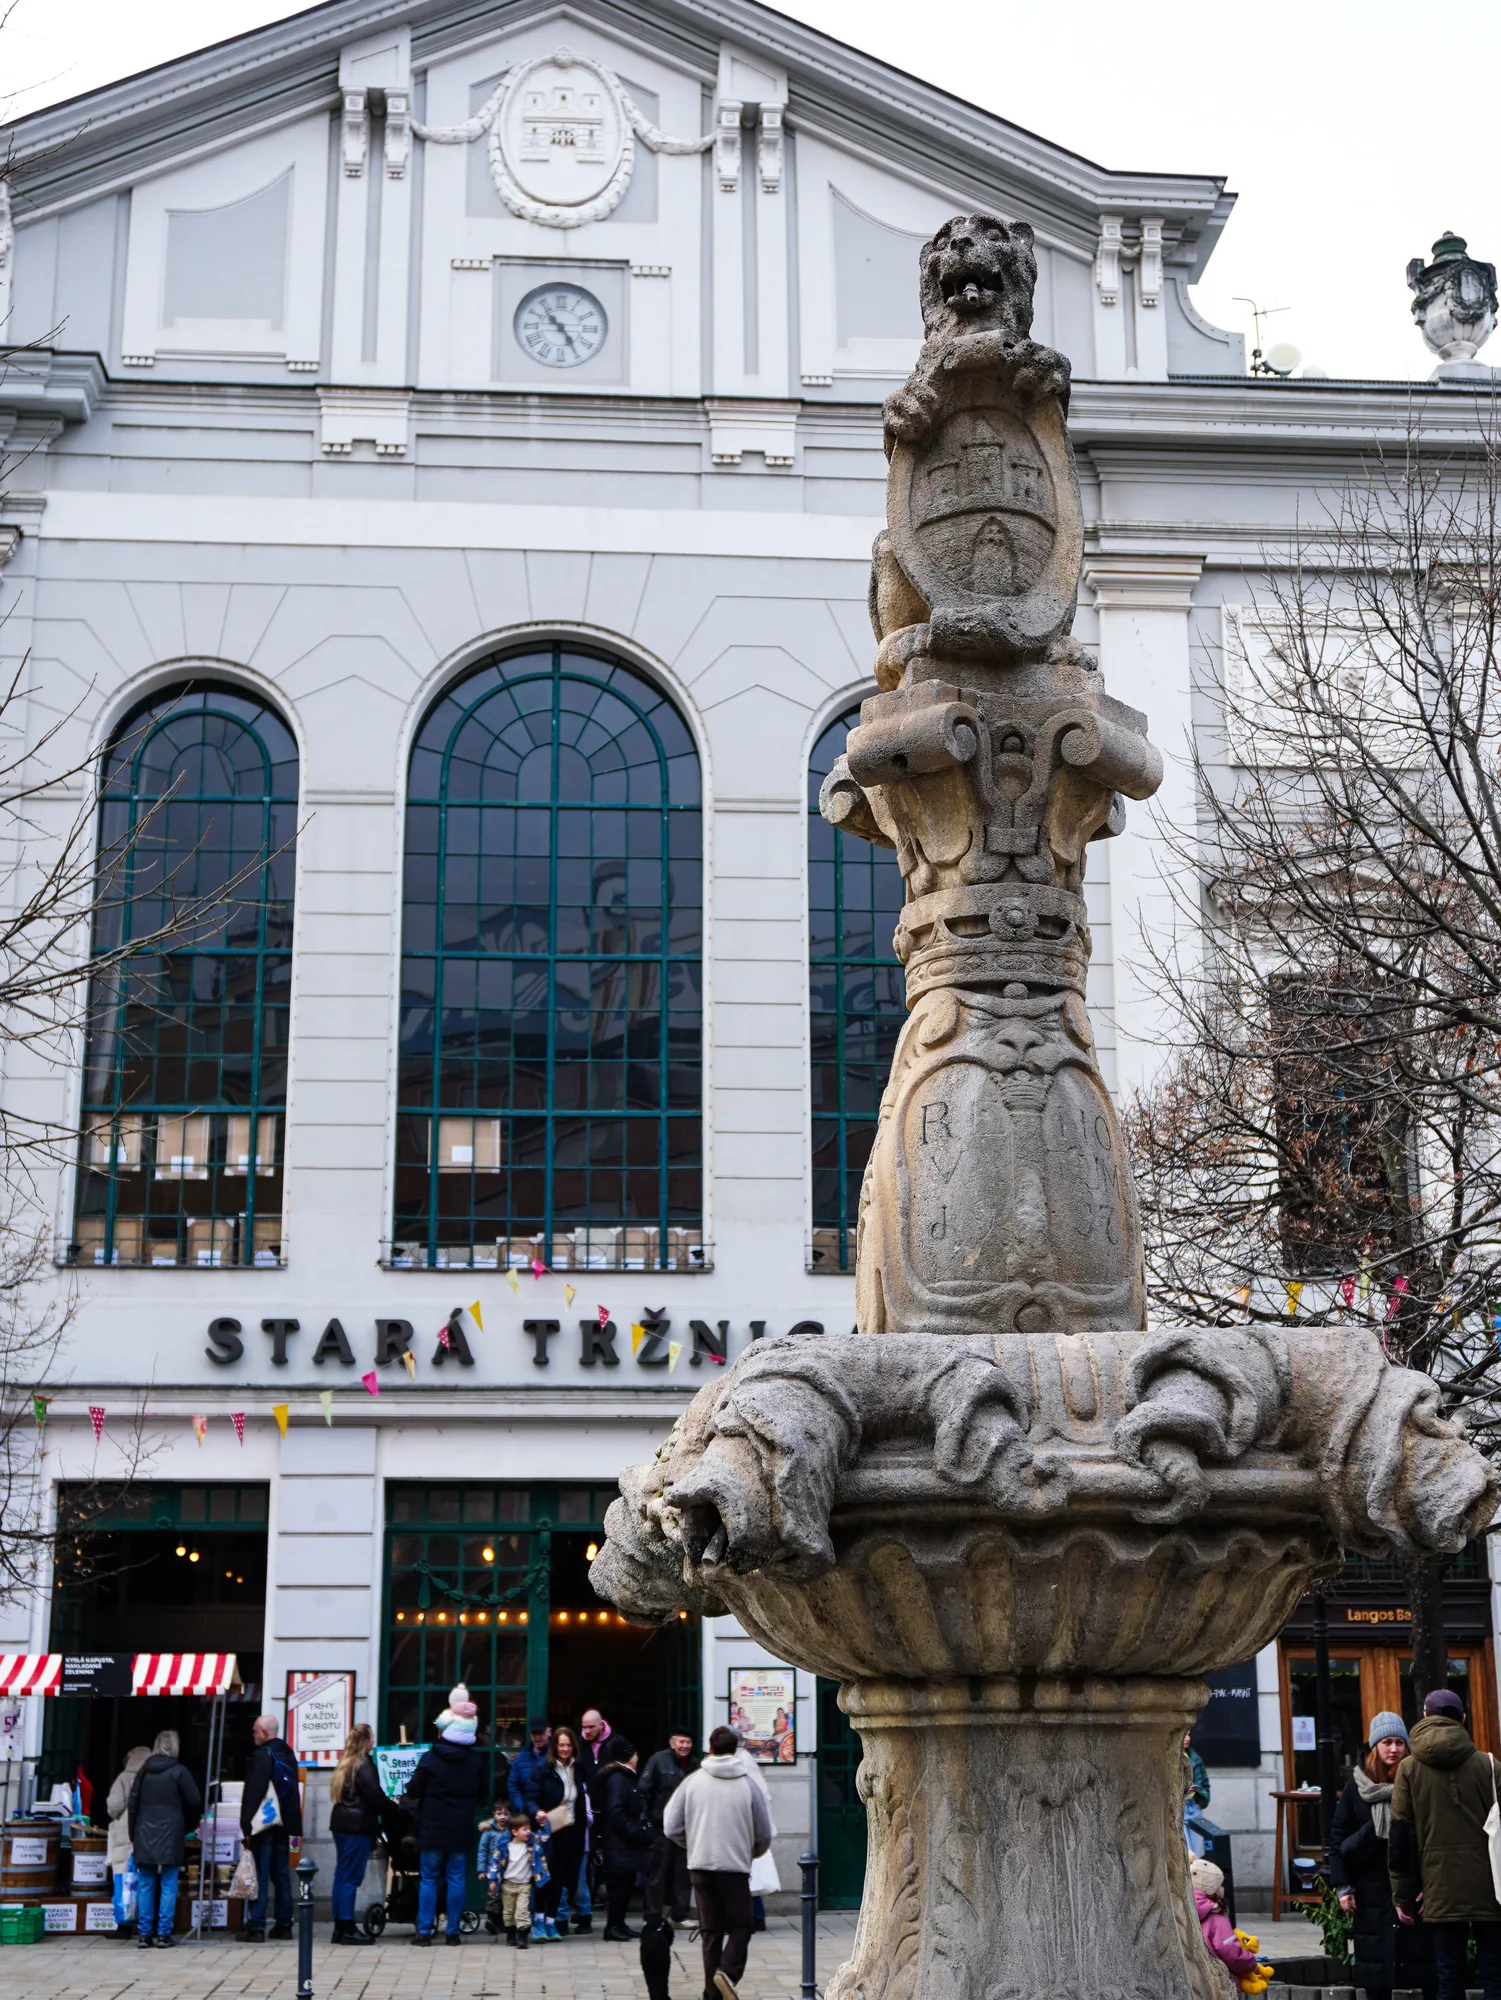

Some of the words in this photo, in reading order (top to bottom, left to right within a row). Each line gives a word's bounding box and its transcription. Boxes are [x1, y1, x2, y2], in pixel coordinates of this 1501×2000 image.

[204, 1307, 475, 1366] STARÁ
[522, 1306, 859, 1367] TRŽN
[1347, 1608, 1395, 1624] Langos
[305, 1710, 339, 1720] KAŽDÚ
[302, 1721, 341, 1731] SOBOTU
[392, 1758, 417, 1768] Stará
